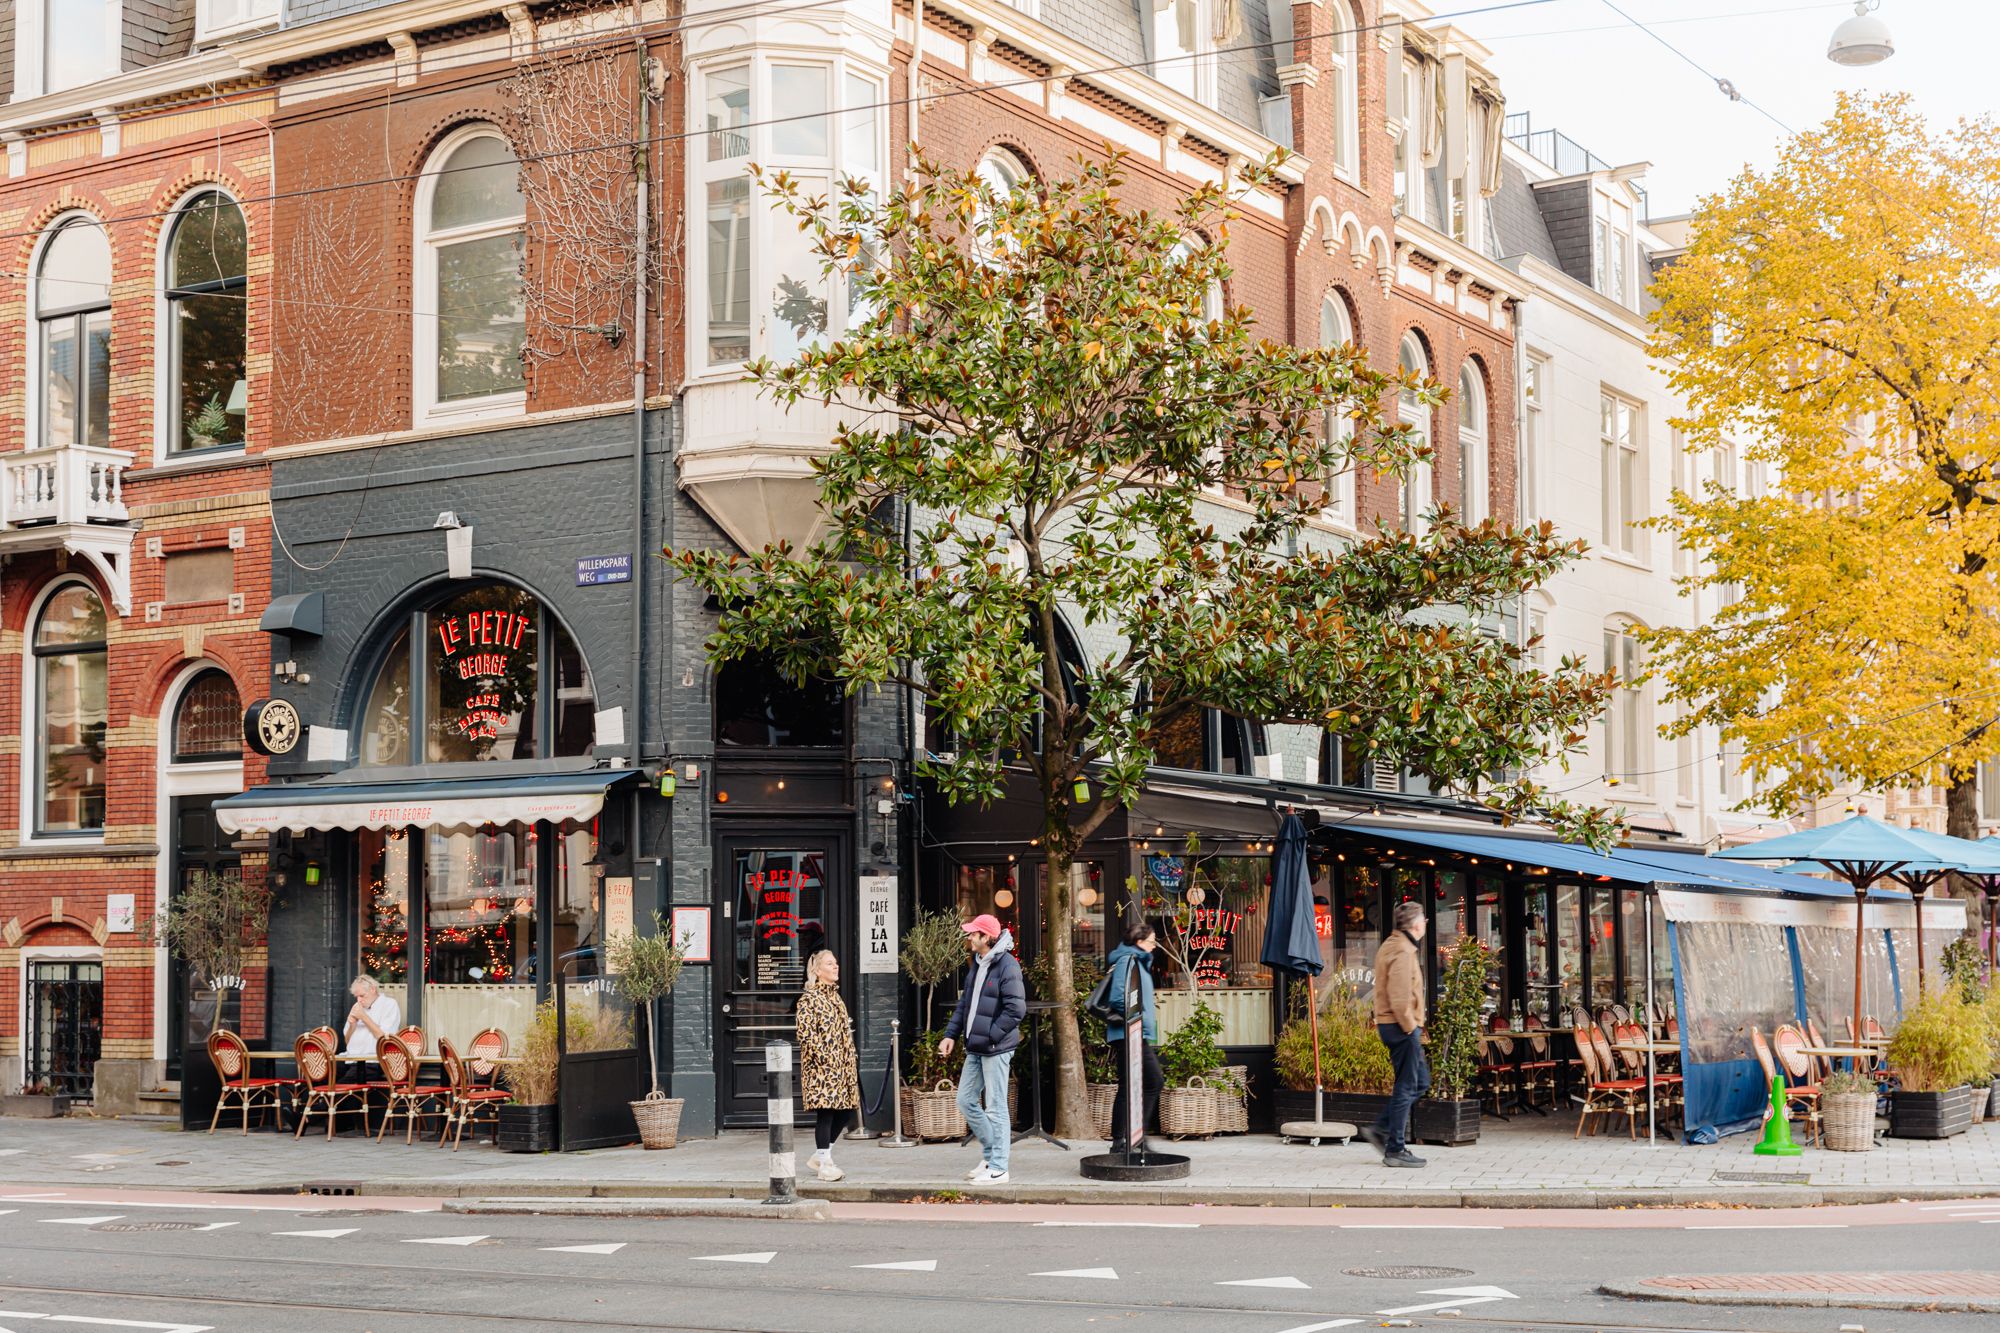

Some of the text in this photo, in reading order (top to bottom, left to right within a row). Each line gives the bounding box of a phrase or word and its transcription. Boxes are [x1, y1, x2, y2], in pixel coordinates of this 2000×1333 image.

[578, 557, 628, 570] WILLEMSPARK
[579, 572, 595, 582] WEG
[439, 610, 529, 656] LE PETIT
[460, 653, 508, 680] GEORGE
[262, 705, 295, 730] Heineken
[458, 709, 508, 731] BISTRO
[469, 724, 497, 741] BAR
[270, 740, 289, 750] Bier
[378, 809, 400, 821] PETIT
[402, 807, 432, 820] GEORGE
[751, 869, 810, 891] LE PETIT
[764, 891, 796, 904] GEORGE
[870, 898, 889, 913] CAFÉ
[874, 914, 885, 926] AU
[1196, 908, 1243, 934] PETIT
[1314, 914, 1332, 936] ER
[871, 928, 888, 940] LA
[871, 942, 888, 954] LA
[1195, 969, 1229, 980] ISTRO
